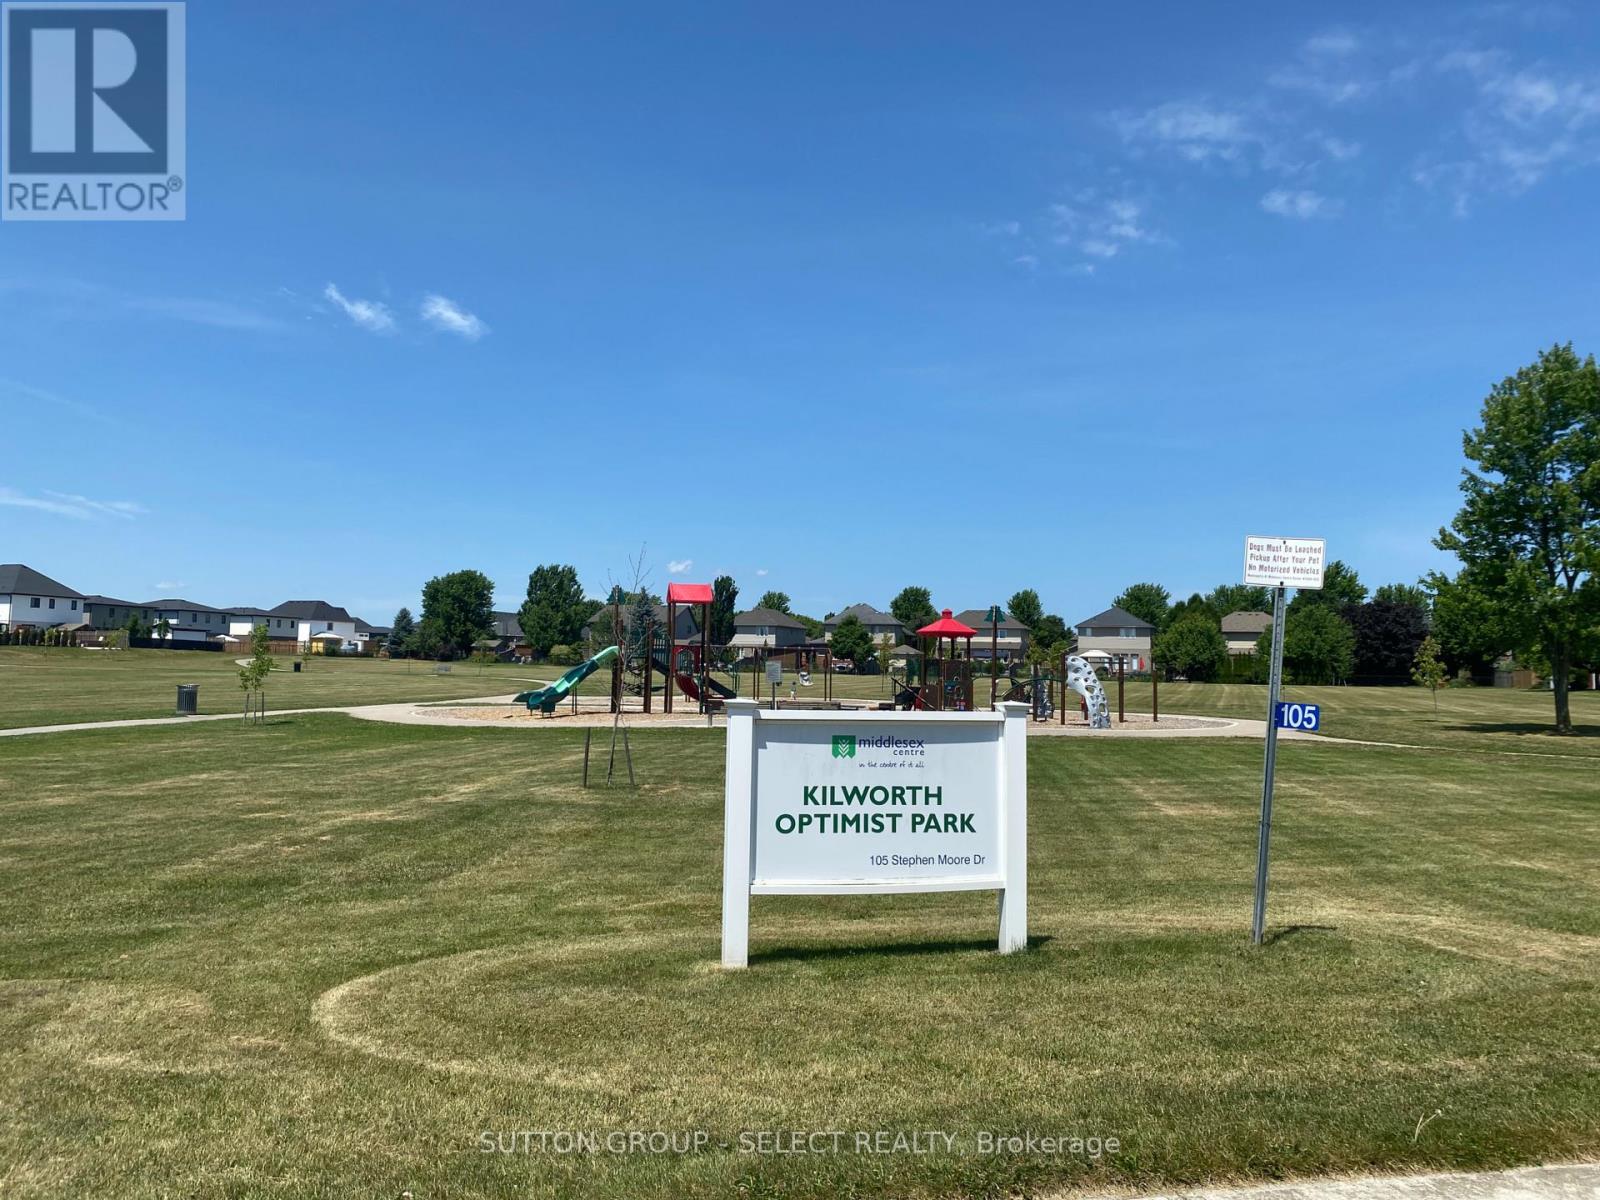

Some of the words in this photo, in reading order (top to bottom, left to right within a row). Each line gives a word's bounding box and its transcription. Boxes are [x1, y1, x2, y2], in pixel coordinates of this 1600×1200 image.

[1249, 543, 1264, 552] Dogs
[1266, 544, 1282, 552] Must
[1284, 545, 1292, 553] Be
[1250, 553, 1271, 562] Pickup
[1273, 555, 1289, 563] After
[1292, 556, 1306, 564] Your
[1248, 563, 1257, 571] No
[1259, 565, 1290, 574] Motorized
[1292, 566, 1320, 575] Vehicles
[1281, 704, 1316, 729] 105
[858, 735, 925, 749] middlesex
[867, 760, 877, 768] the
[899, 760, 906, 768] of
[915, 760, 925, 768] all
[803, 786, 943, 806] KILWORTH
[775, 813, 902, 834] OPTIMIST
[911, 813, 977, 833] PARK
[870, 855, 889, 866] 105
[891, 855, 935, 868] Stephen
[937, 854, 971, 865] Moore
[973, 854, 986, 865] Dr
